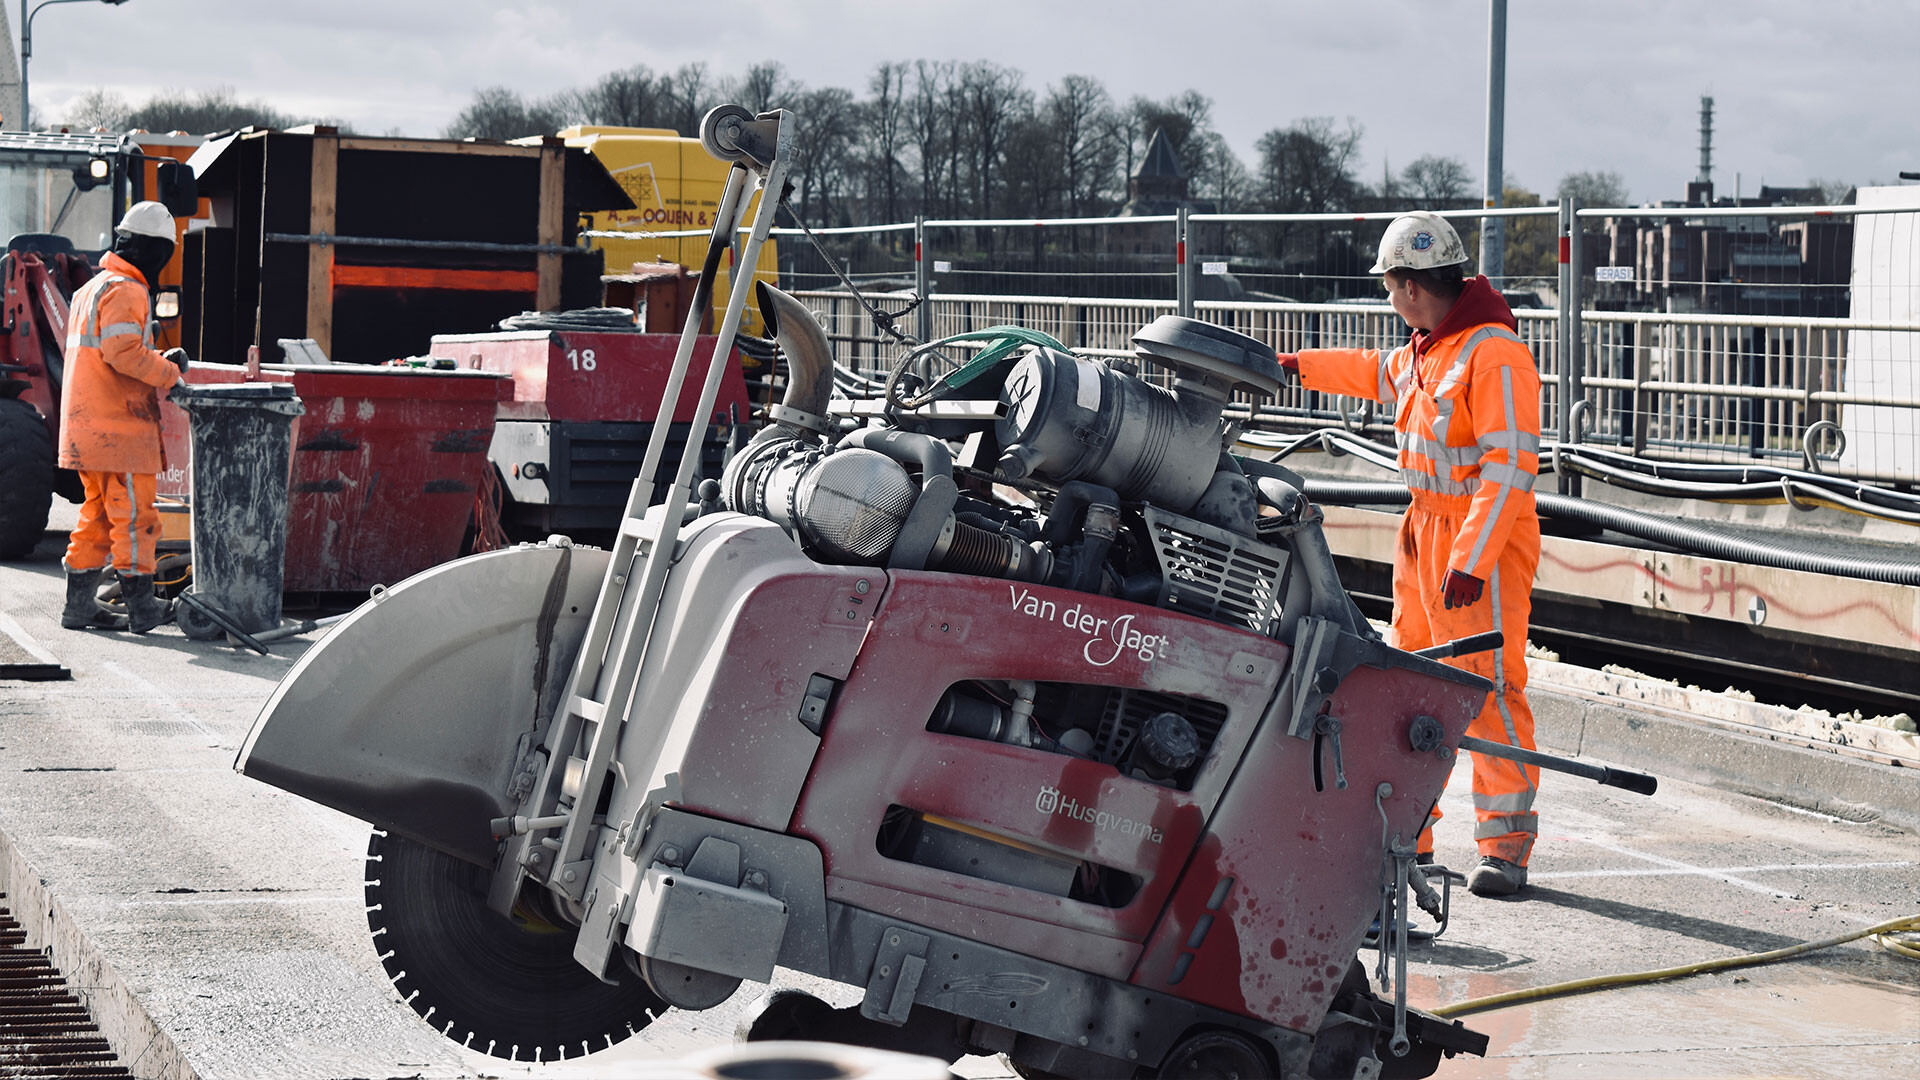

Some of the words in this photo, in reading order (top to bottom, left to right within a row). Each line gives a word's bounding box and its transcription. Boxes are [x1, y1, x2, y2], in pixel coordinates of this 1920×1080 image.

[643, 208, 693, 225] OOIJEN
[698, 211, 707, 226] &
[566, 348, 597, 371] 18
[1009, 584, 1056, 622] Van
[1700, 565, 1736, 618] 54
[1062, 603, 1108, 637] der
[1083, 614, 1169, 667] Jagt
[1058, 794, 1164, 844] Husqvarna
